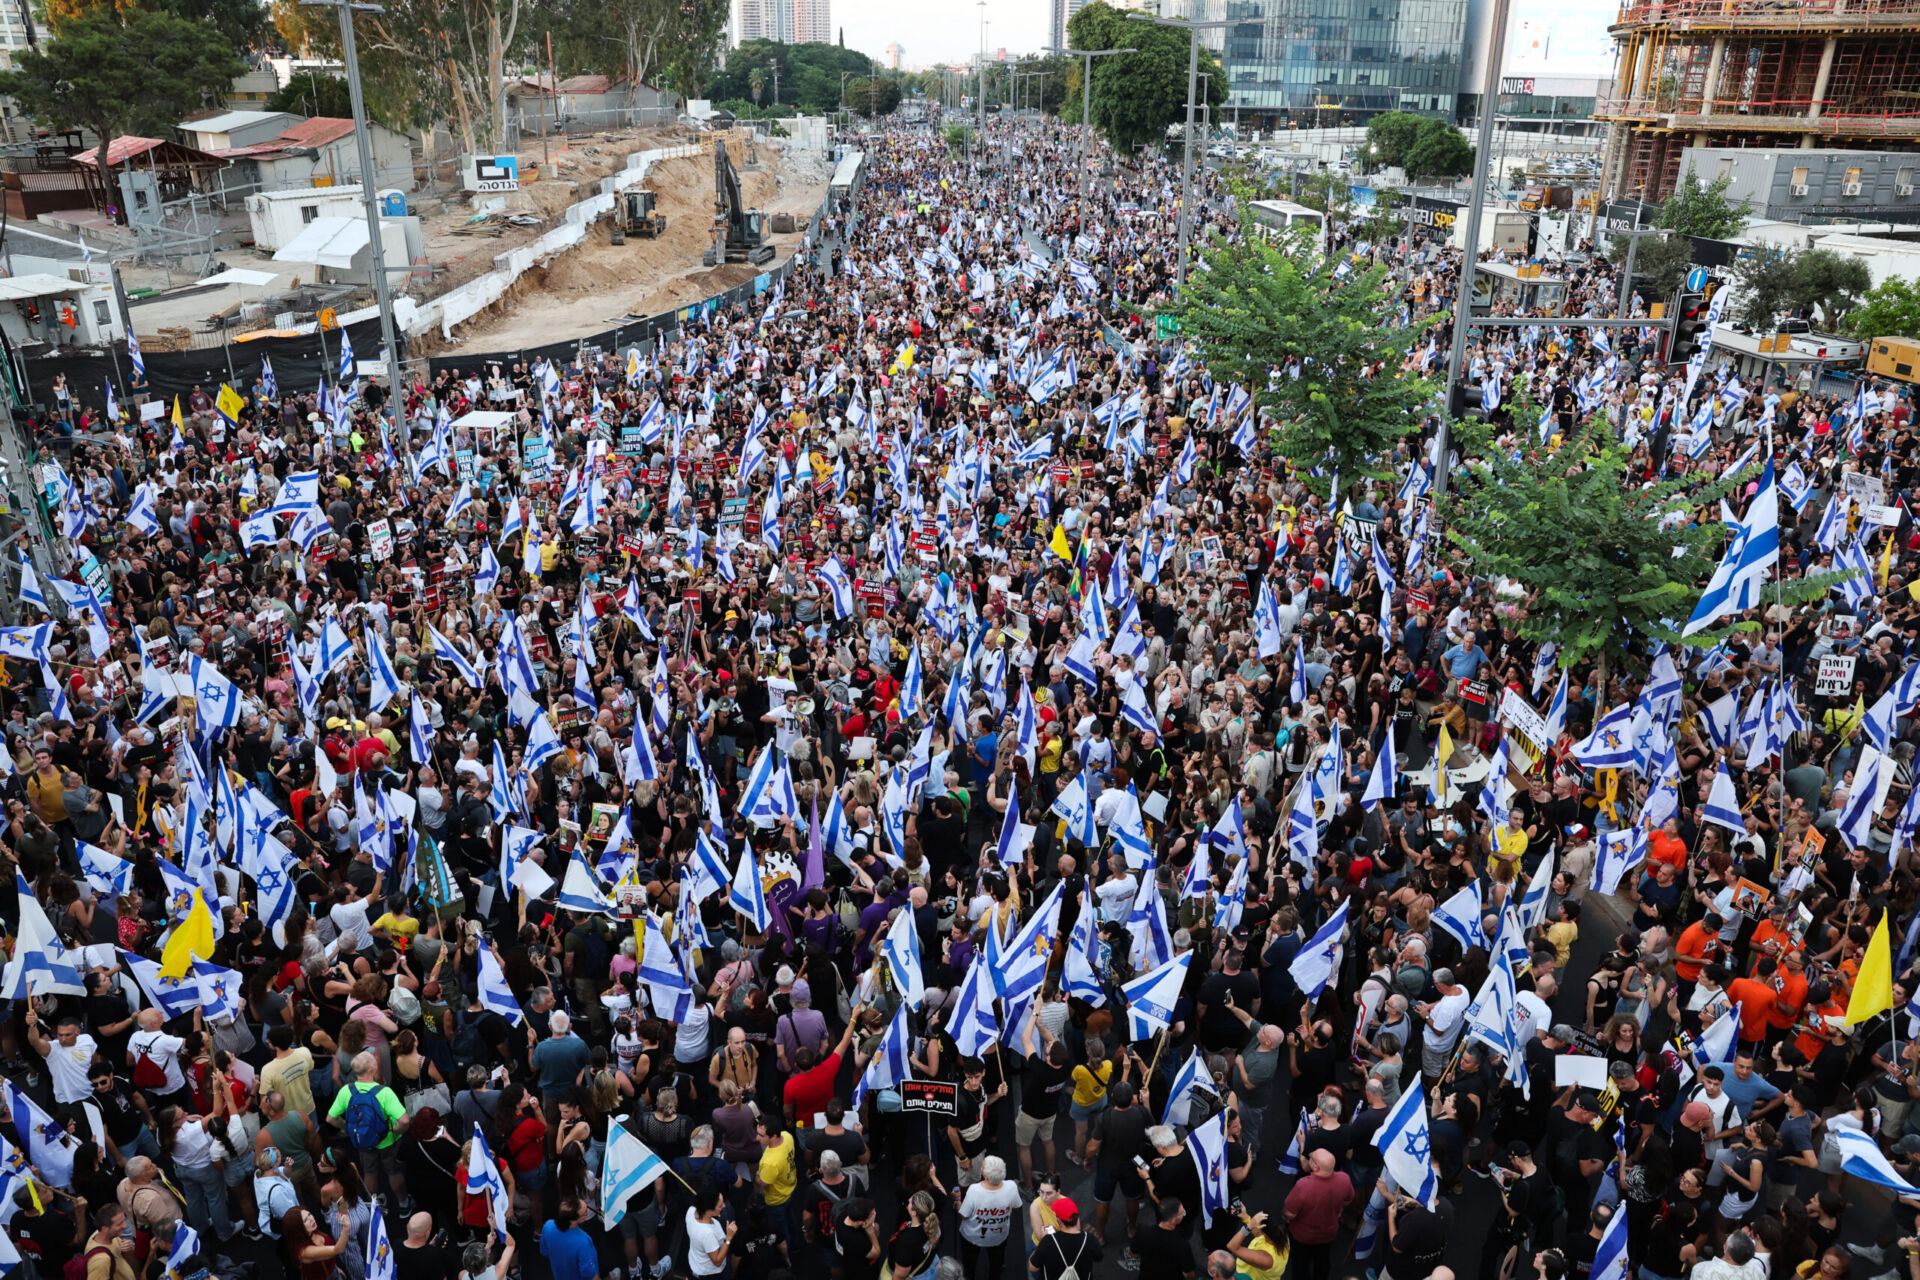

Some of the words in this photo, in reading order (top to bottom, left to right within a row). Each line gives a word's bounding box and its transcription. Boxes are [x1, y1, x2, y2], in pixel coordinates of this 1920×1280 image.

[1610, 218, 1630, 231] WXG
[1825, 659, 1851, 669] רואה
[1821, 669, 1846, 678] ואינה
[1816, 679, 1851, 691] נראית
[904, 1083, 922, 1091] אותו
[923, 1084, 954, 1095] מחליפים
[906, 1098, 926, 1107] אותם
[927, 1100, 953, 1110] מצילים
